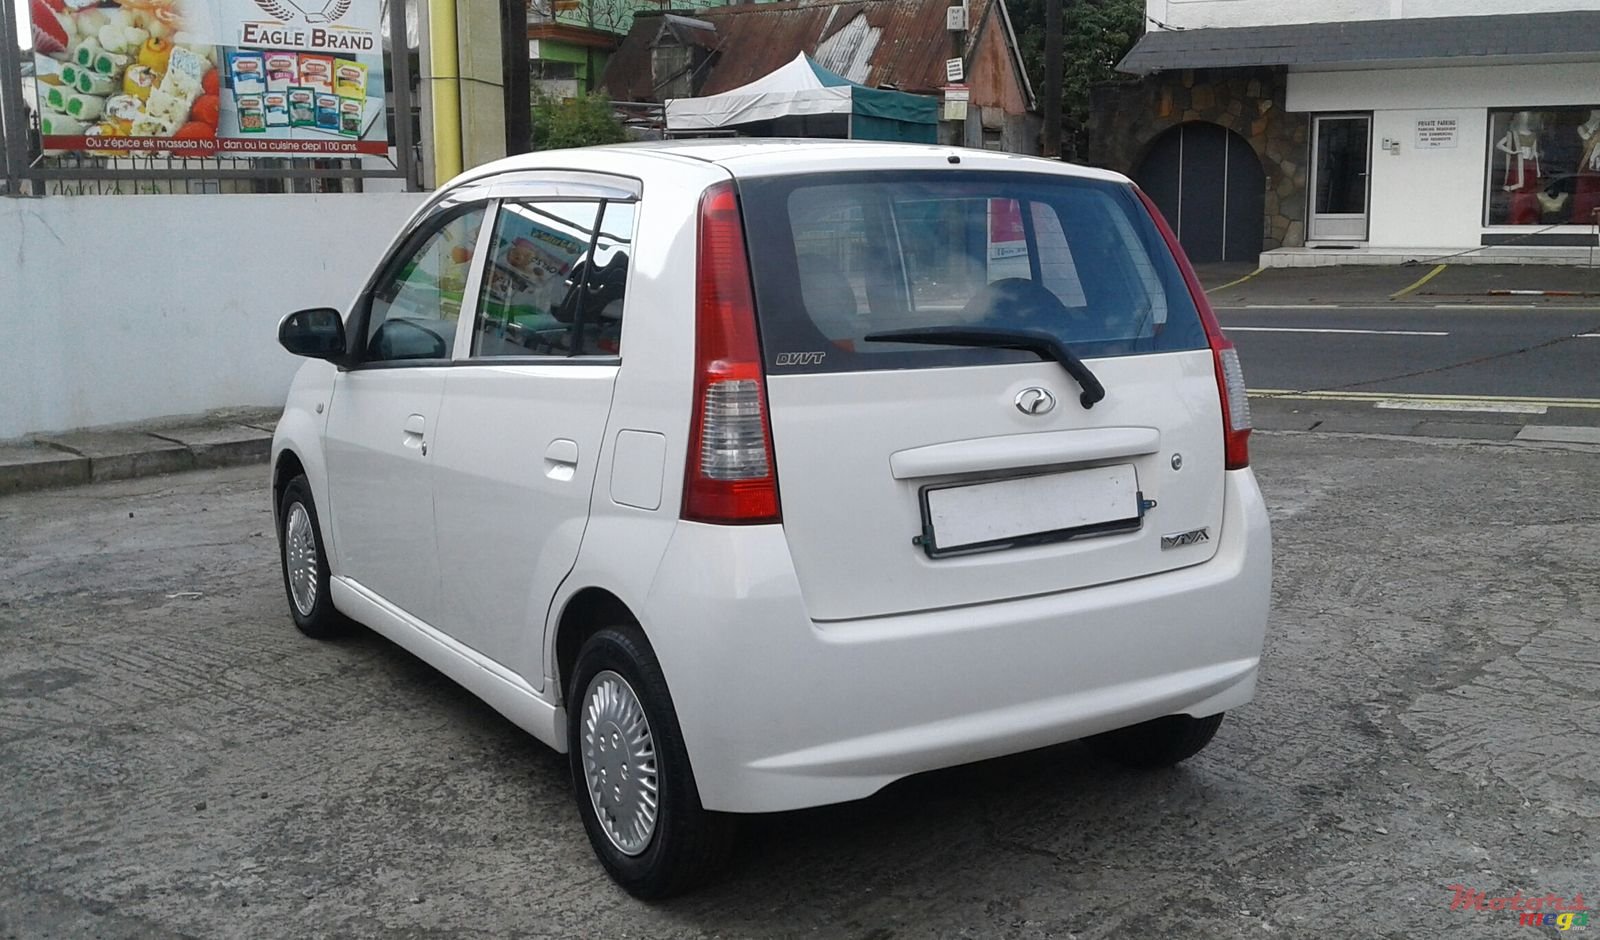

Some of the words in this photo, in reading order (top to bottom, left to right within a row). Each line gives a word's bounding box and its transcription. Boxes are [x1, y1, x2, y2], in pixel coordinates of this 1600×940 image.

[243, 23, 305, 46] EAGLE
[311, 28, 374, 50] BRAND
[85, 137, 101, 147] Ou
[103, 137, 140, 149] z'épice
[142, 138, 156, 148] ek
[157, 139, 198, 149] massala
[223, 140, 242, 150] dan
[244, 142, 257, 150] ou
[258, 140, 268, 150] la
[269, 140, 300, 150] cuisine
[301, 141, 321, 152] depi
[324, 141, 340, 151] 100
[775, 351, 826, 366] DVVT
